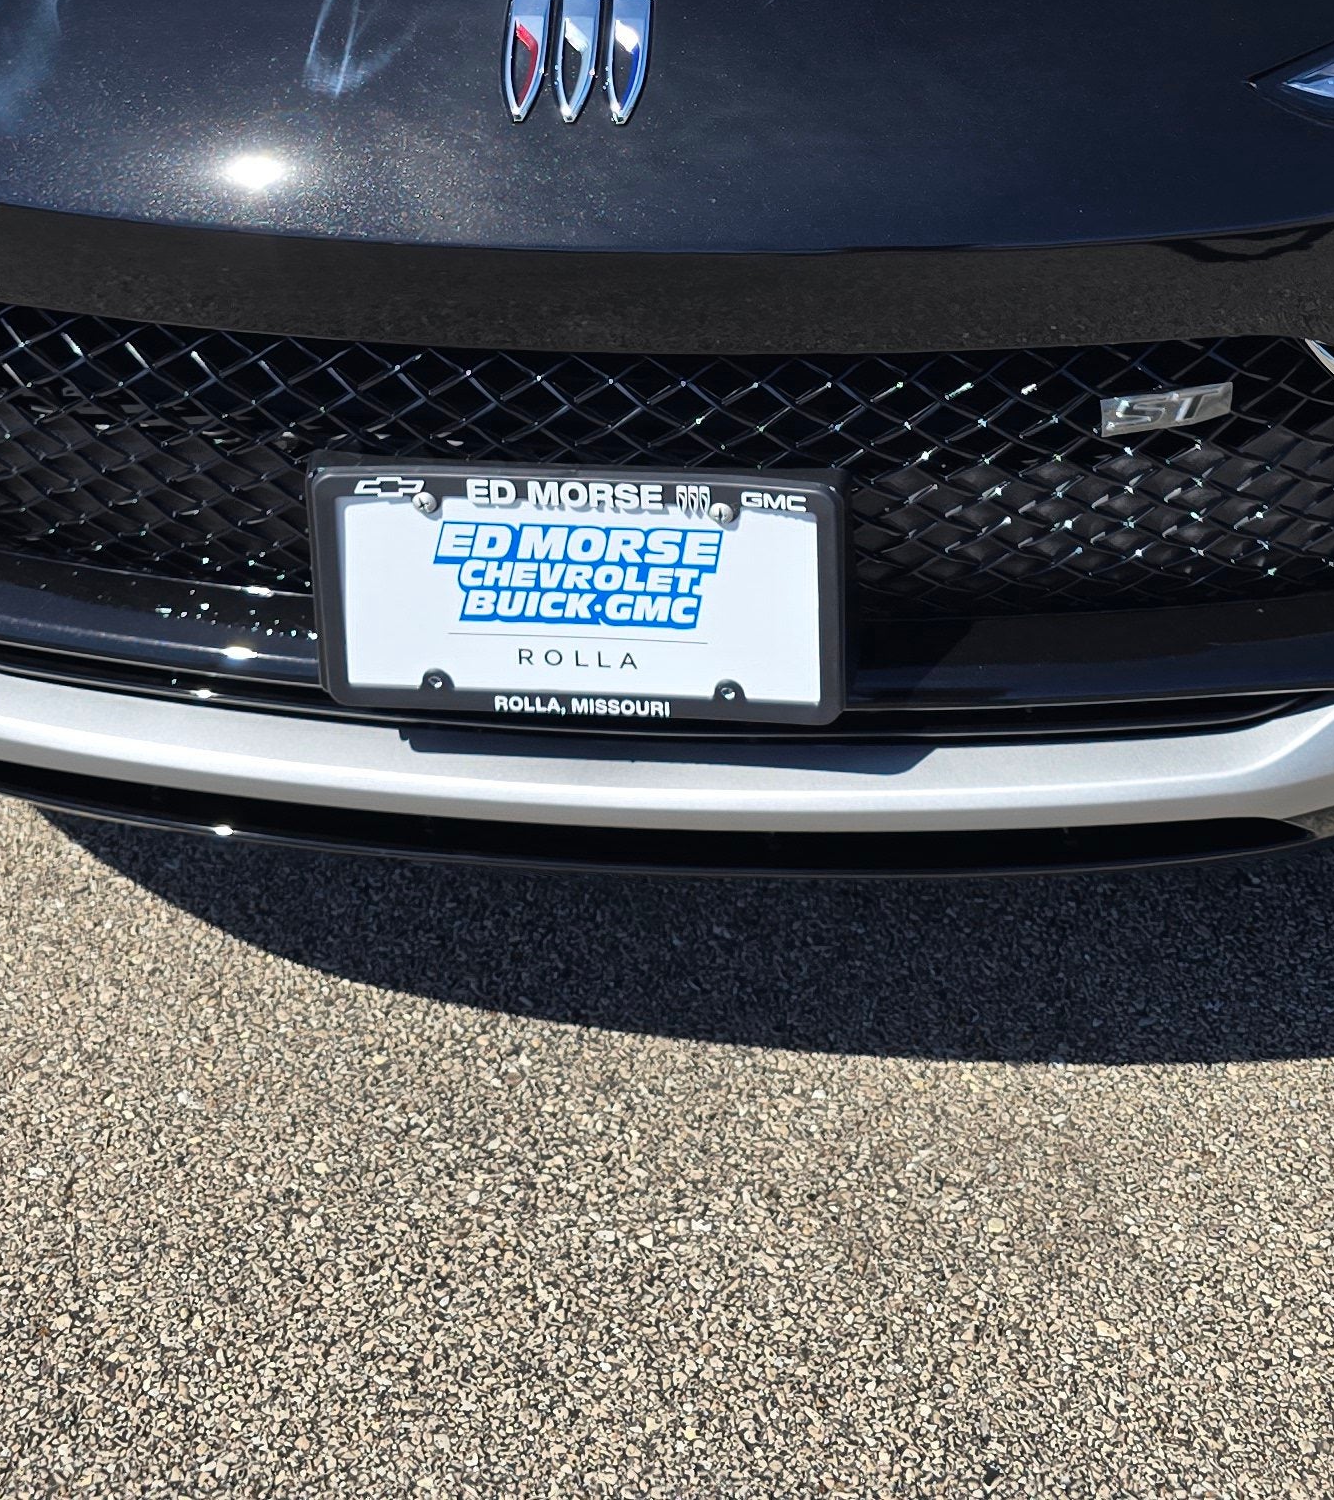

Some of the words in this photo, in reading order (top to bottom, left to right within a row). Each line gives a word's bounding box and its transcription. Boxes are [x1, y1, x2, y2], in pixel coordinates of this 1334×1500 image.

[1103, 386, 1222, 431] ST
[466, 479, 516, 505] ED
[527, 480, 664, 510] MORSE
[741, 491, 807, 512] GMC
[436, 523, 513, 559] ED
[516, 525, 721, 566] MORSE
[518, 648, 638, 670] ROLLA
[494, 694, 567, 717] ROLLA,
[571, 697, 672, 719] MISSOURI
